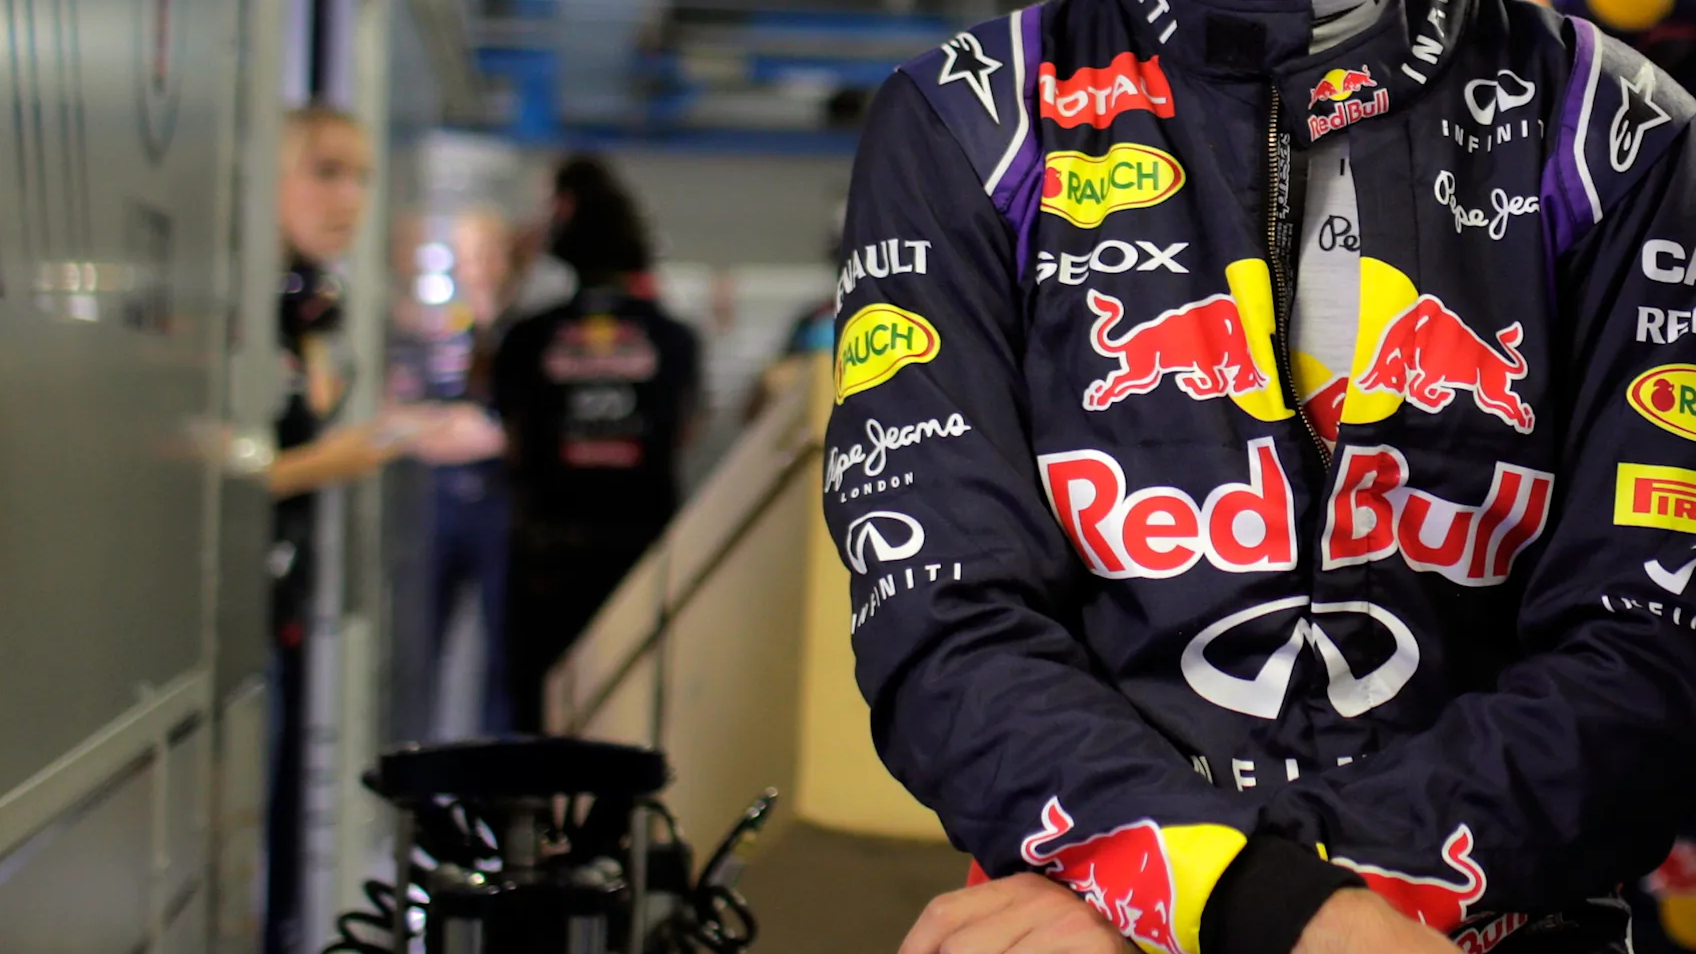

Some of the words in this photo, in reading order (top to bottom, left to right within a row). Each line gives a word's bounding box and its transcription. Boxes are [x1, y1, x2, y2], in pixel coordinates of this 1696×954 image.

[1039, 74, 1166, 118] TOTAL
[1307, 101, 1347, 142] Red
[1344, 88, 1389, 125] Bull
[1067, 161, 1160, 205] RAUCH
[1434, 169, 1490, 234] Pepe
[864, 412, 971, 477] Jeans
[840, 471, 915, 503] LONDON
[1038, 436, 1298, 579] Red
[1322, 444, 1554, 586] Bull
[851, 562, 962, 634] INFINITI
